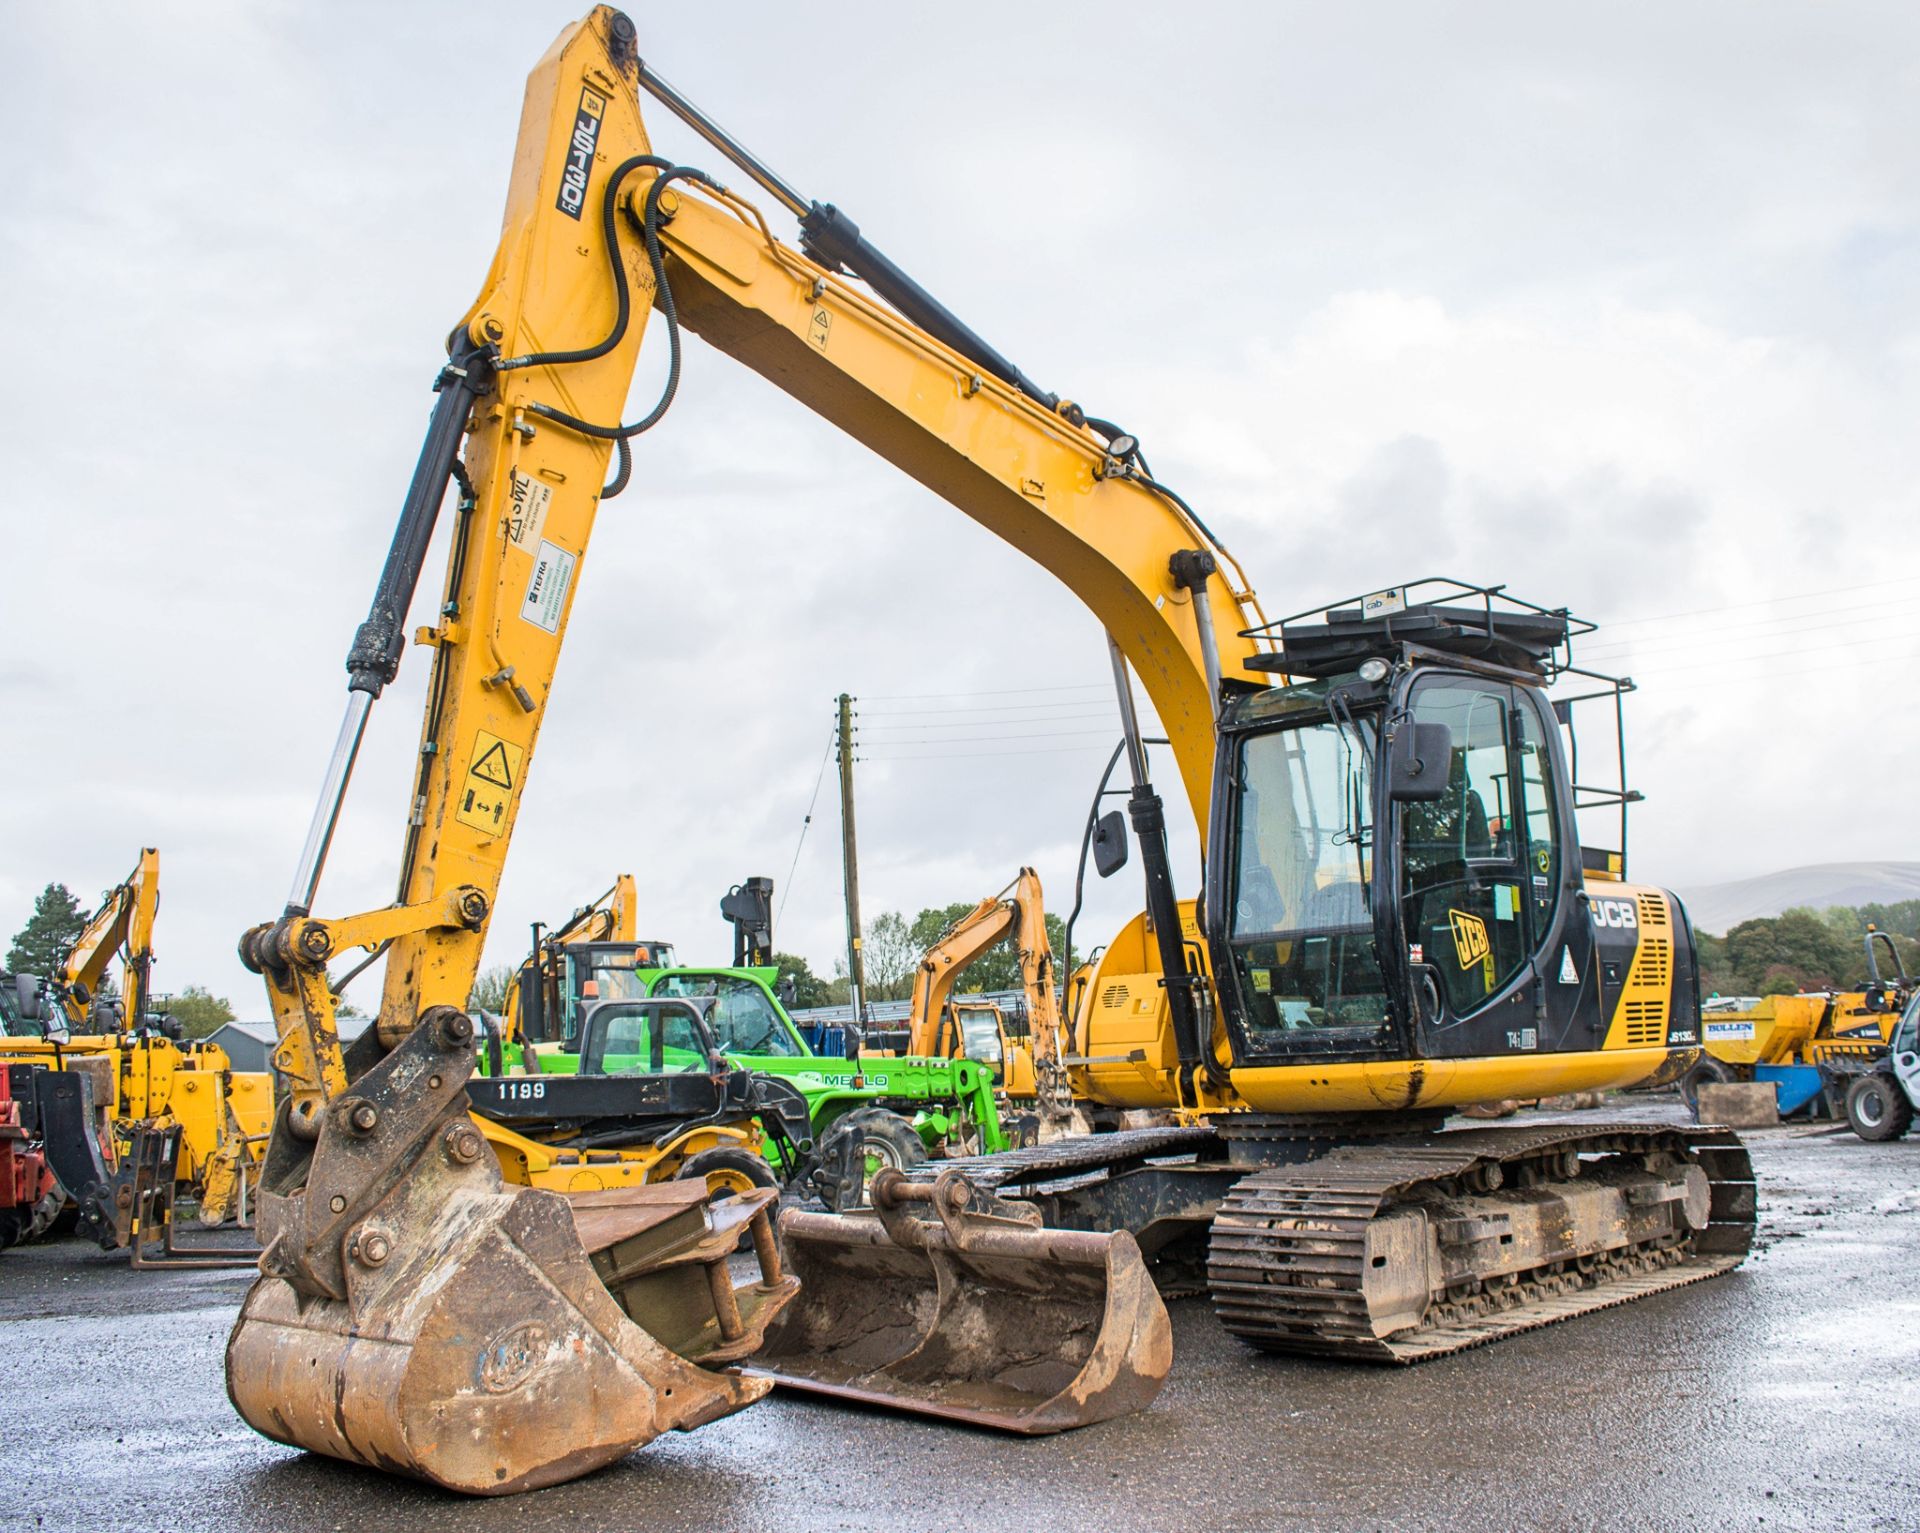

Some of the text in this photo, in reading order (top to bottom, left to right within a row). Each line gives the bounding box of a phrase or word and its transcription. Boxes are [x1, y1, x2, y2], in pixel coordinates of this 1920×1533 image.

[561, 118, 598, 207] JS130
[512, 479, 530, 515] SWL
[533, 560, 547, 592] TEFRA
[1590, 900, 1637, 928] JCB
[1456, 916, 1487, 963] JCB
[1708, 1023, 1753, 1032] BULLEN
[498, 1082, 545, 1100] 1199
[824, 1075, 888, 1086] MELO
